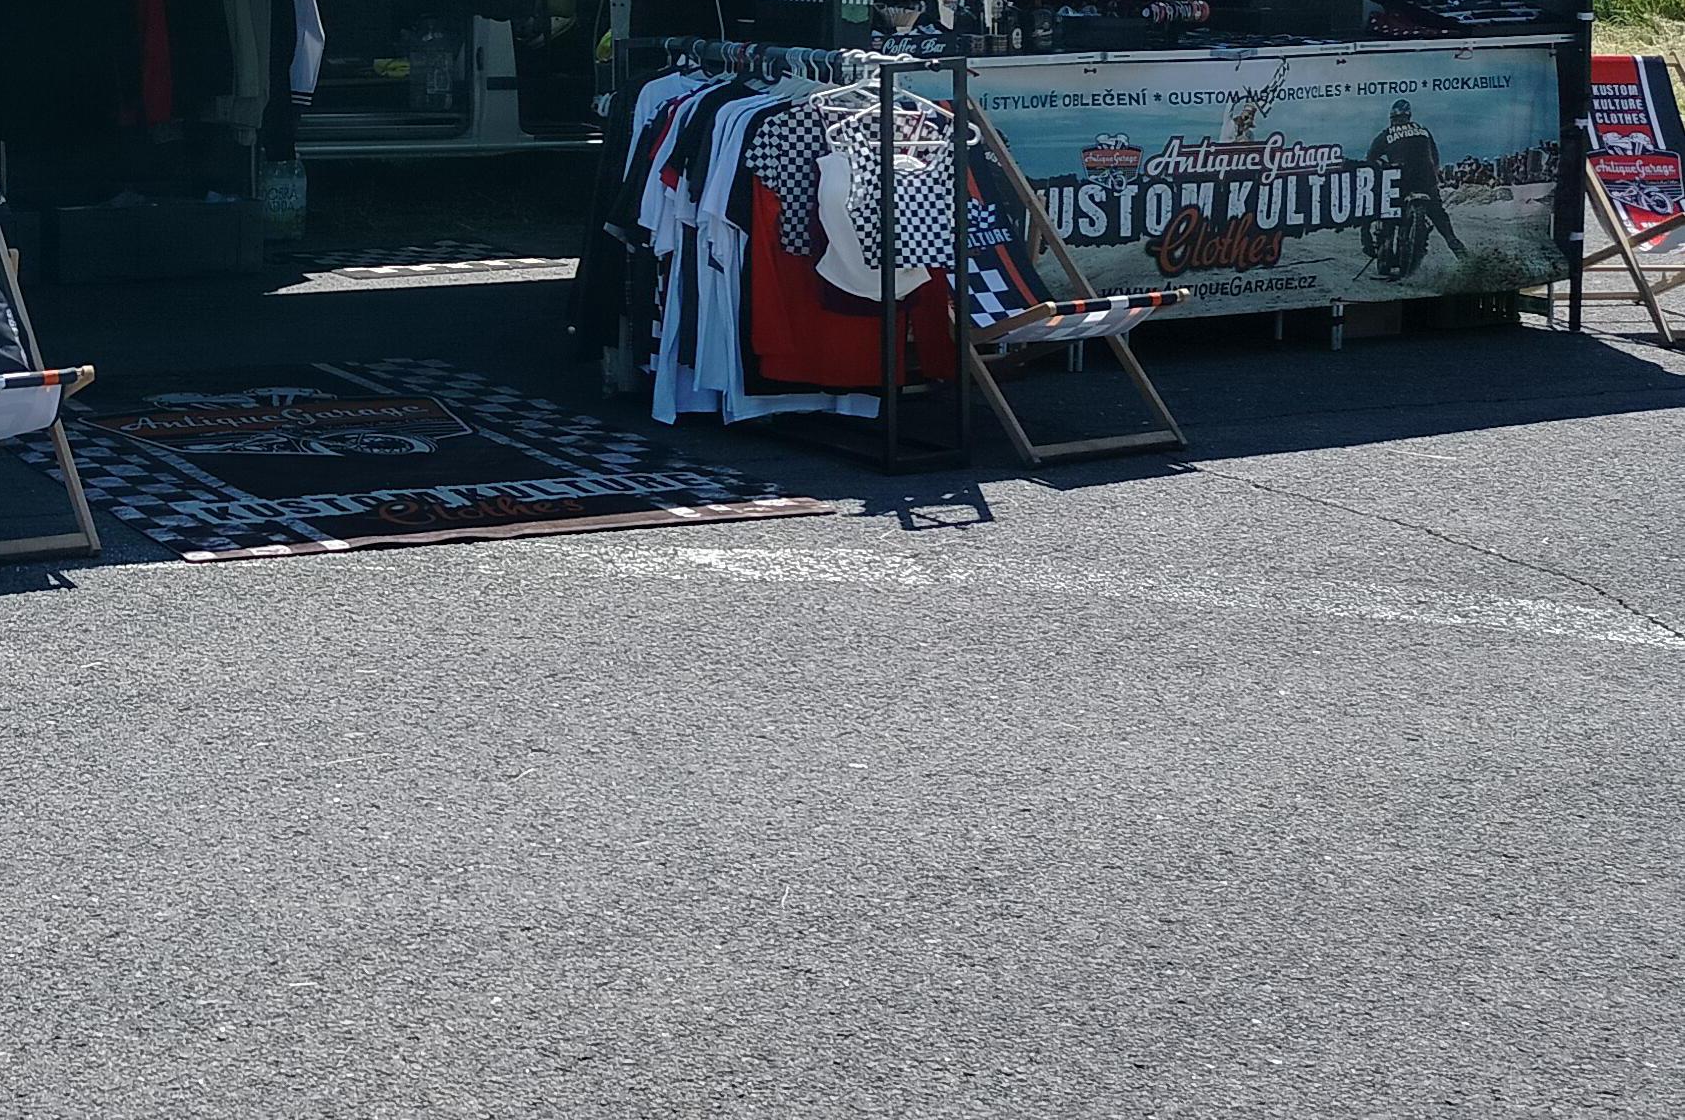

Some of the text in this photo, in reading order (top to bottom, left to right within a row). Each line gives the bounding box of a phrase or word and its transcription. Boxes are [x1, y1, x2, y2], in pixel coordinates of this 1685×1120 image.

[882, 38, 946, 54] Coffee Bar
[992, 90, 1058, 110] STYLOVÉ
[1062, 88, 1148, 107] OBLEČENÍ
[1168, 89, 1240, 106] CUSTOM
[1247, 84, 1342, 103] MOTORCYCLES
[1356, 79, 1418, 96] HOTROD
[1432, 75, 1512, 92] ROCKABILLY
[1591, 84, 1639, 96] KUSTOM
[1592, 98, 1644, 110] KULTURE
[1595, 112, 1648, 124] CLOTHES
[1227, 168, 1403, 230] KULTURE
[1151, 206, 1282, 273] Clothes
